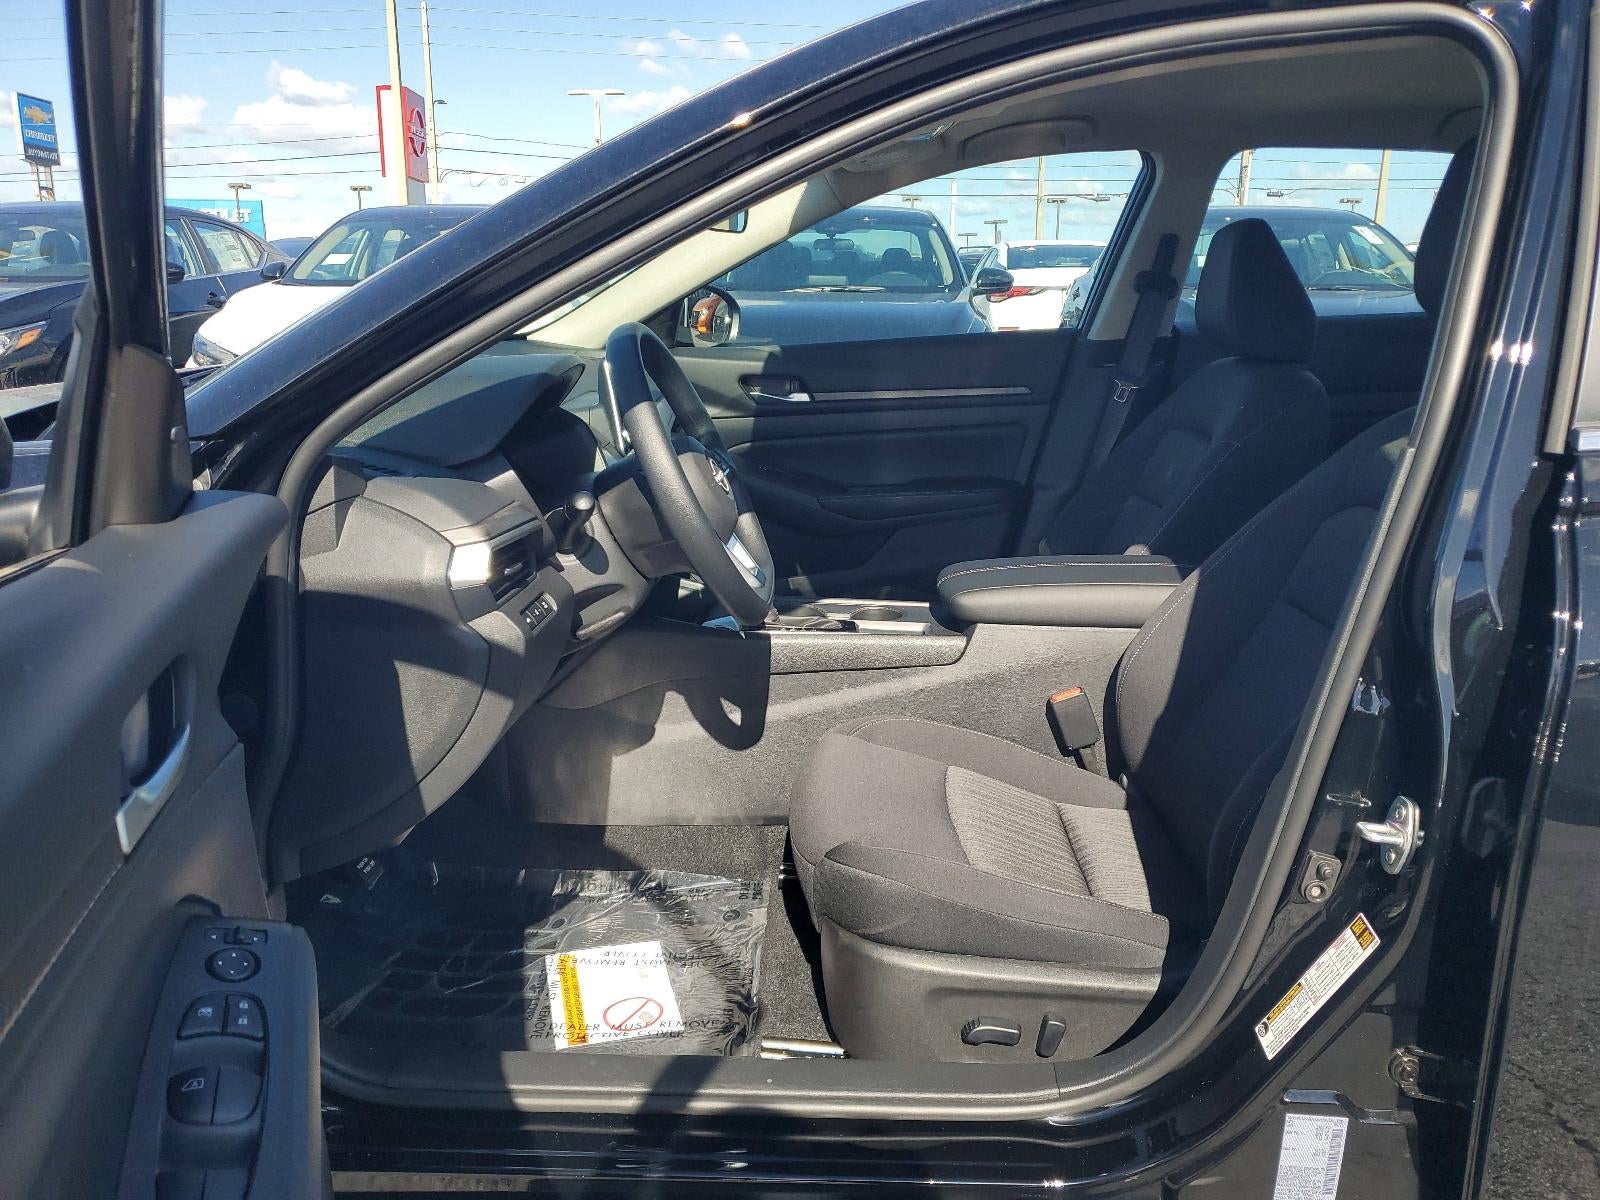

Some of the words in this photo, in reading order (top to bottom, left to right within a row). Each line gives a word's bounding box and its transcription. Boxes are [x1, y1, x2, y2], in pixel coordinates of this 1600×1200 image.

[531, 1005, 550, 1039] REMOVE
[549, 1022, 600, 1031] DEALER
[659, 1019, 720, 1030] REMOVE
